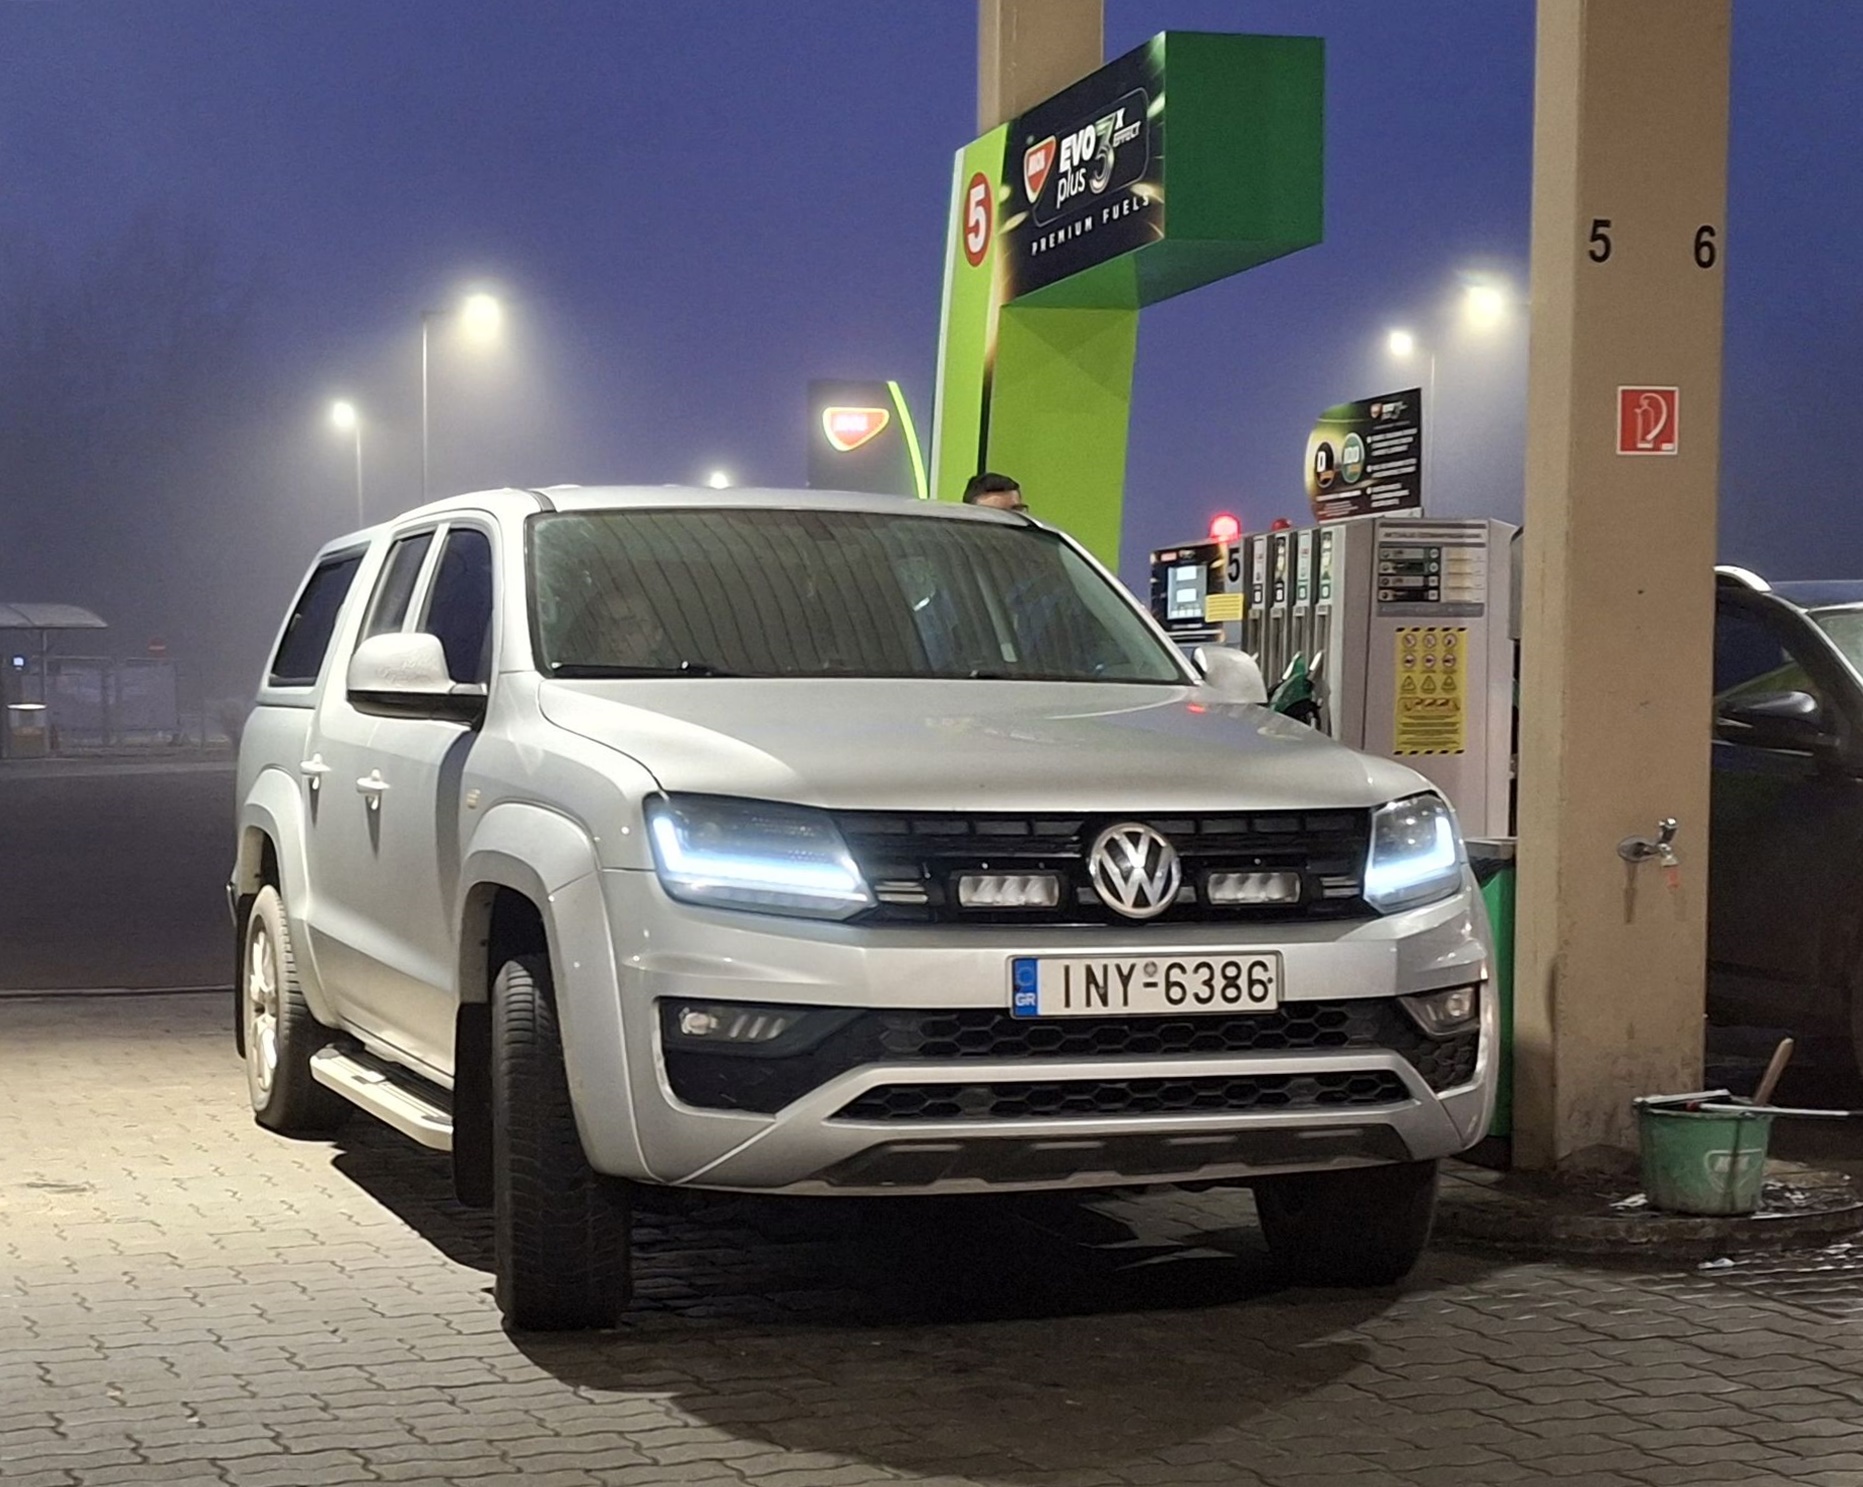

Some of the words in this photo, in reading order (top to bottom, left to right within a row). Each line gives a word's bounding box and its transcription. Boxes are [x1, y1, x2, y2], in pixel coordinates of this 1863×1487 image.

[1059, 124, 1097, 173] EVO
[1056, 166, 1087, 209] plus
[967, 183, 987, 254] 5
[1031, 216, 1093, 256] PREMIUM
[1102, 195, 1150, 224] FUELS
[1588, 218, 1612, 263] 5
[1693, 224, 1716, 269] 6
[1228, 547, 1241, 583] 5
[1015, 992, 1036, 1007] GR
